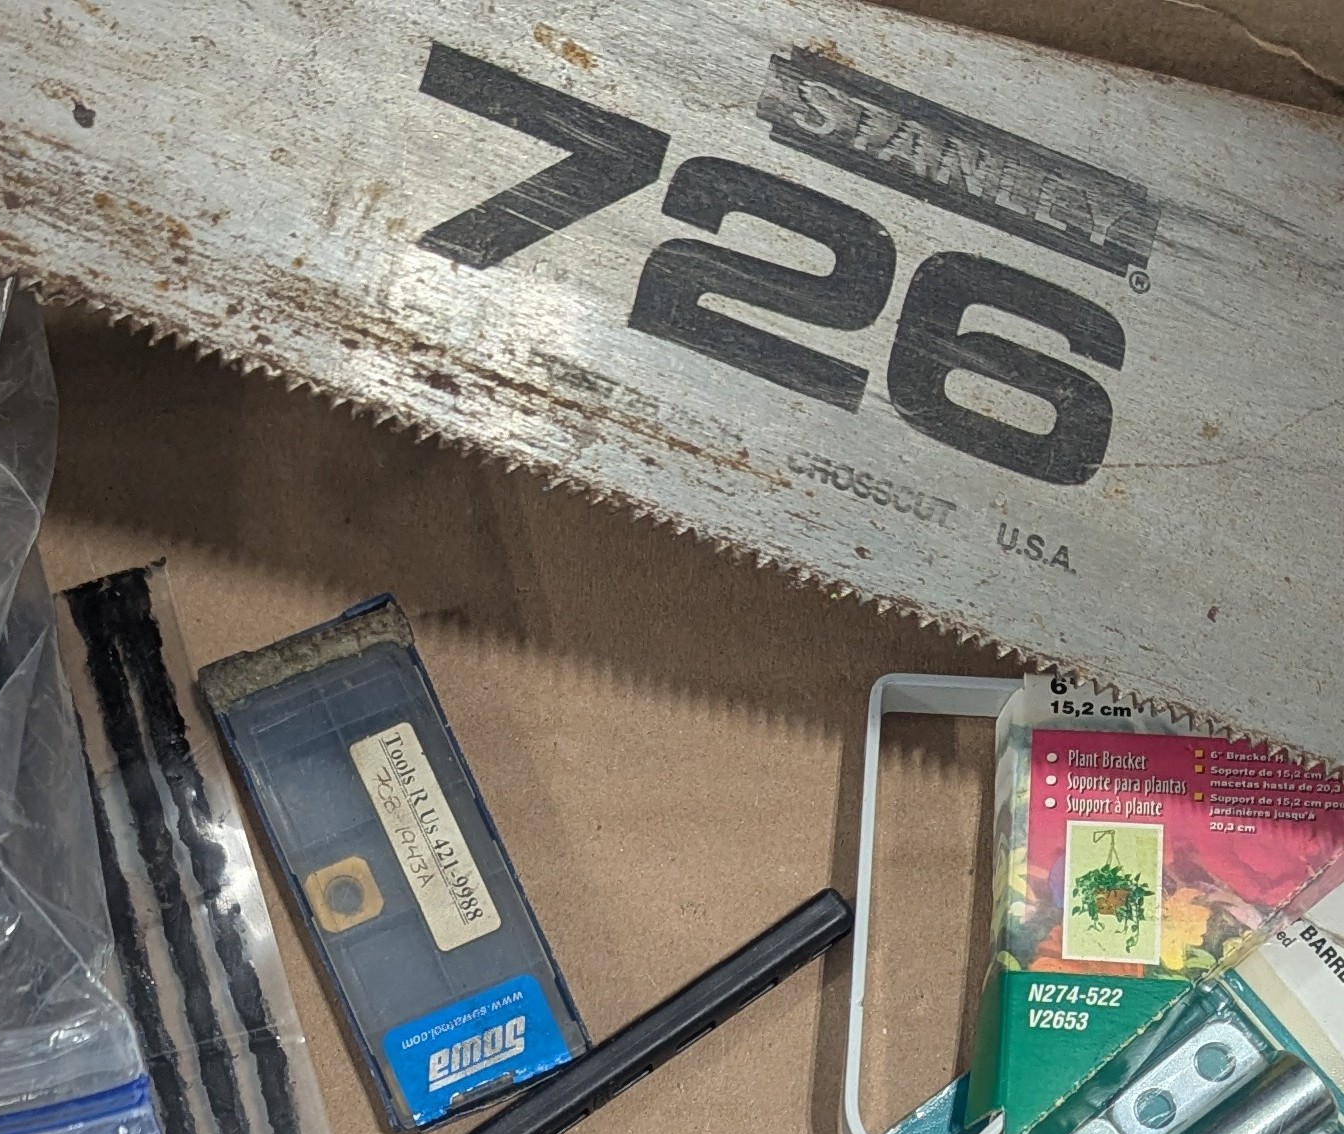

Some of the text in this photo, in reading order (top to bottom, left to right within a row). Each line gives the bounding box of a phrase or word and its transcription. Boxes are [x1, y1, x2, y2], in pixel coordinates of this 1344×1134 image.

[791, 78, 1140, 249] STANLEY
[416, 41, 1126, 486] 726
[788, 452, 1078, 577] CROSSCUT U.S.A.
[1049, 699, 1132, 718] 15,2 cm
[1067, 748, 1148, 771] Plant Bracket
[1065, 771, 1187, 796] Soporte para plantas
[1209, 764, 1257, 778] Soporte
[1258, 767, 1274, 778] de
[1303, 770, 1322, 780] cm
[1209, 777, 1260, 790] macetas
[1262, 780, 1295, 791] hasta
[1297, 781, 1313, 792] de
[1315, 782, 1341, 795] 20,3
[1064, 793, 1163, 818] Support à plante
[1209, 792, 1256, 806] Support
[1257, 795, 1273, 806] de
[1301, 798, 1322, 808] cm
[1208, 804, 1315, 822] jardinières jusqu'à
[381, 731, 484, 922] Tools R Us 421-9988
[1208, 821, 1256, 834] 20,3 cm
[1027, 982, 1123, 1007] N274-522
[1027, 1008, 1089, 1031] V2653
